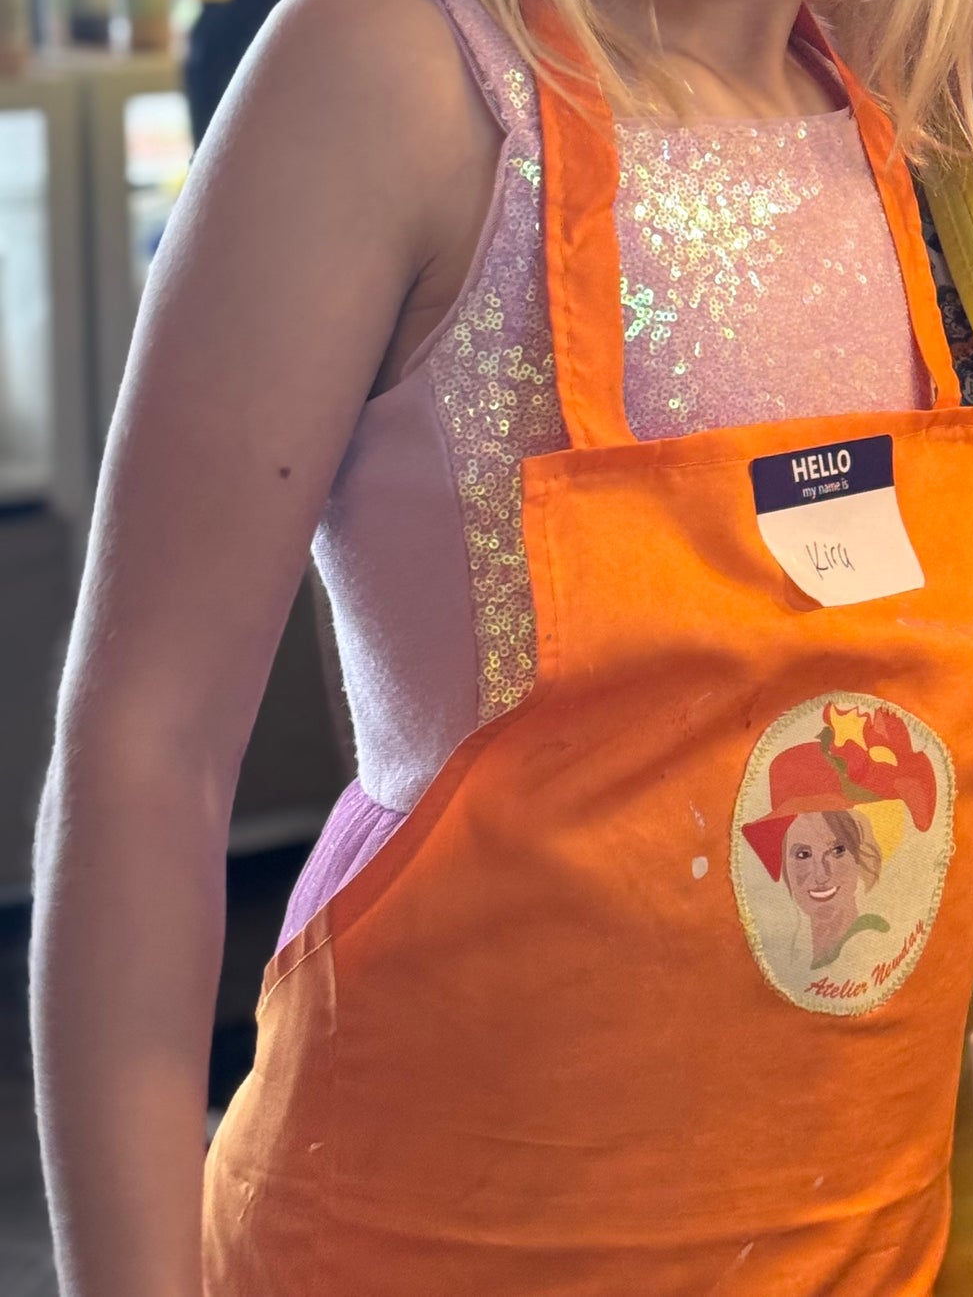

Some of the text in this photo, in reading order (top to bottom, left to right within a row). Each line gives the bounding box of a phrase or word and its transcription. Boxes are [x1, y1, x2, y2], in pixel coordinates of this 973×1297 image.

[791, 449, 852, 483] HELLO
[802, 477, 850, 500] my name is
[805, 540, 856, 581] Kira
[804, 976, 868, 999] Atelier
